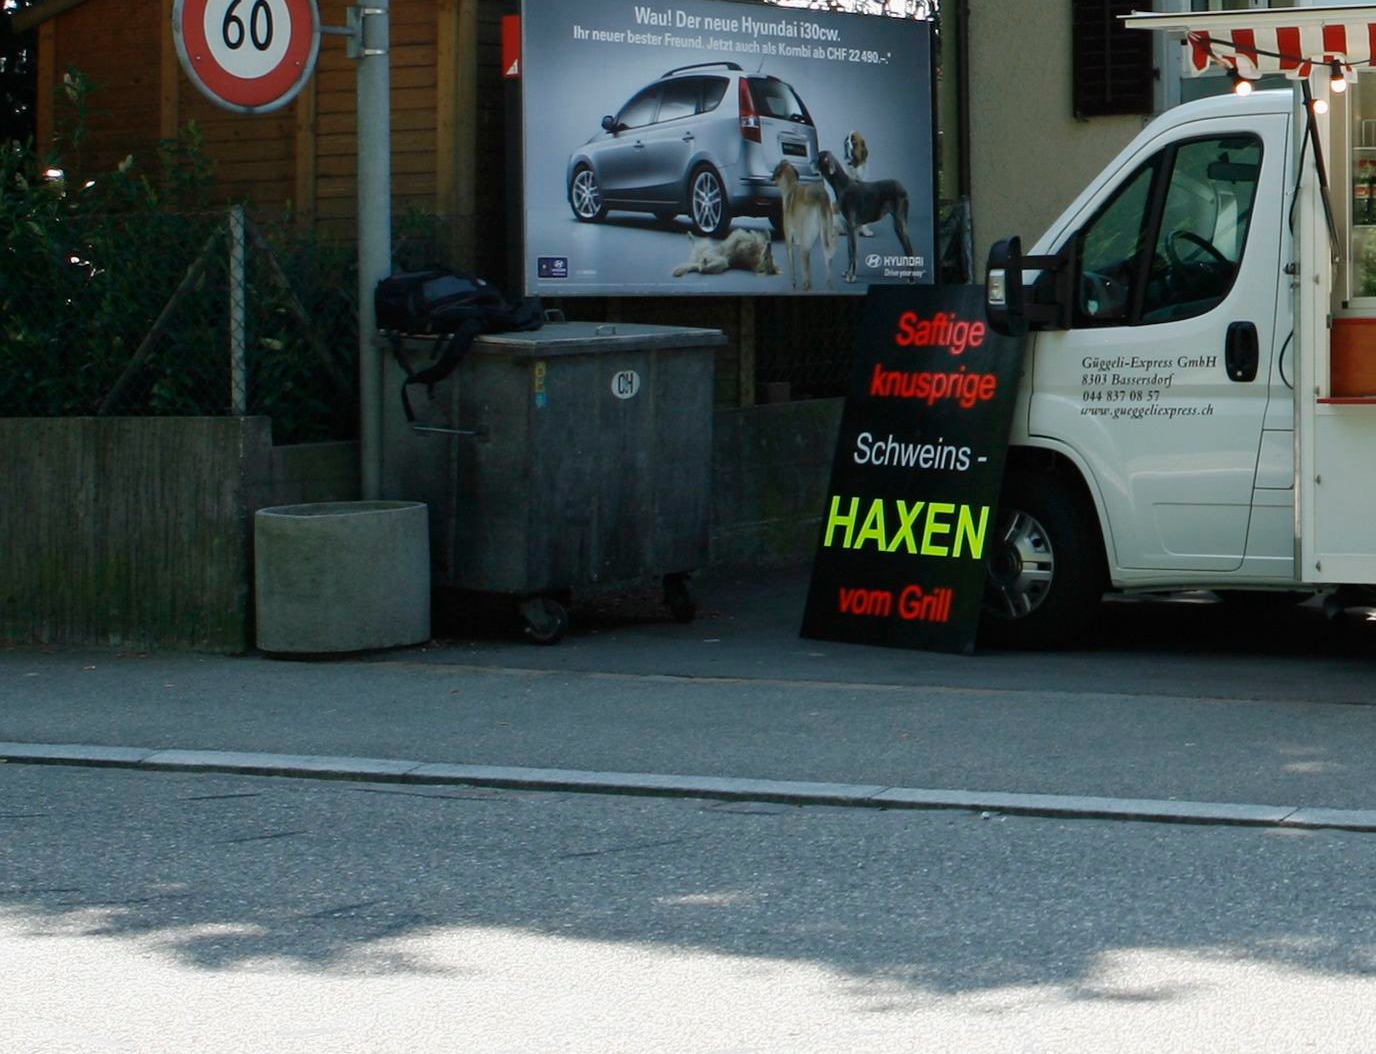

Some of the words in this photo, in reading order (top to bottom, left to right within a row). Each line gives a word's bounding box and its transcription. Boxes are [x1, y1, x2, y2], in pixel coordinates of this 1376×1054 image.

[634, 6, 672, 27] Wau!
[675, 10, 701, 29] Der
[704, 18, 739, 33] neue
[742, 16, 797, 39] Hyundai
[800, 21, 841, 42] i30cw.
[573, 25, 590, 40] Ihr
[592, 29, 625, 43] neuer
[627, 30, 662, 46] bester
[665, 33, 704, 49] Freund.
[706, 38, 733, 52] Jetzt
[735, 41, 761, 54] auch
[762, 42, 777, 55] als
[778, 43, 811, 58] Kombi
[813, 46, 825, 59] ab
[827, 47, 847, 61] CHF
[883, 256, 925, 267] HYUNDAI
[895, 310, 986, 355] Saftige
[1081, 373, 1107, 385] 8303
[1111, 372, 1175, 388] Bassersdorf
[1082, 356, 1173, 371] Güggeli-Express
[1177, 355, 1217, 368] GmbH
[870, 362, 997, 409] knusprige
[1082, 390, 1102, 401] 044
[1106, 390, 1126, 401] 837
[1129, 390, 1143, 401] 08
[1146, 389, 1161, 401] 57
[1080, 403, 1214, 419] www.gueggeliexpress.ch
[823, 495, 991, 560] HAXEN
[838, 587, 892, 617] vom
[898, 583, 954, 623] Grill
